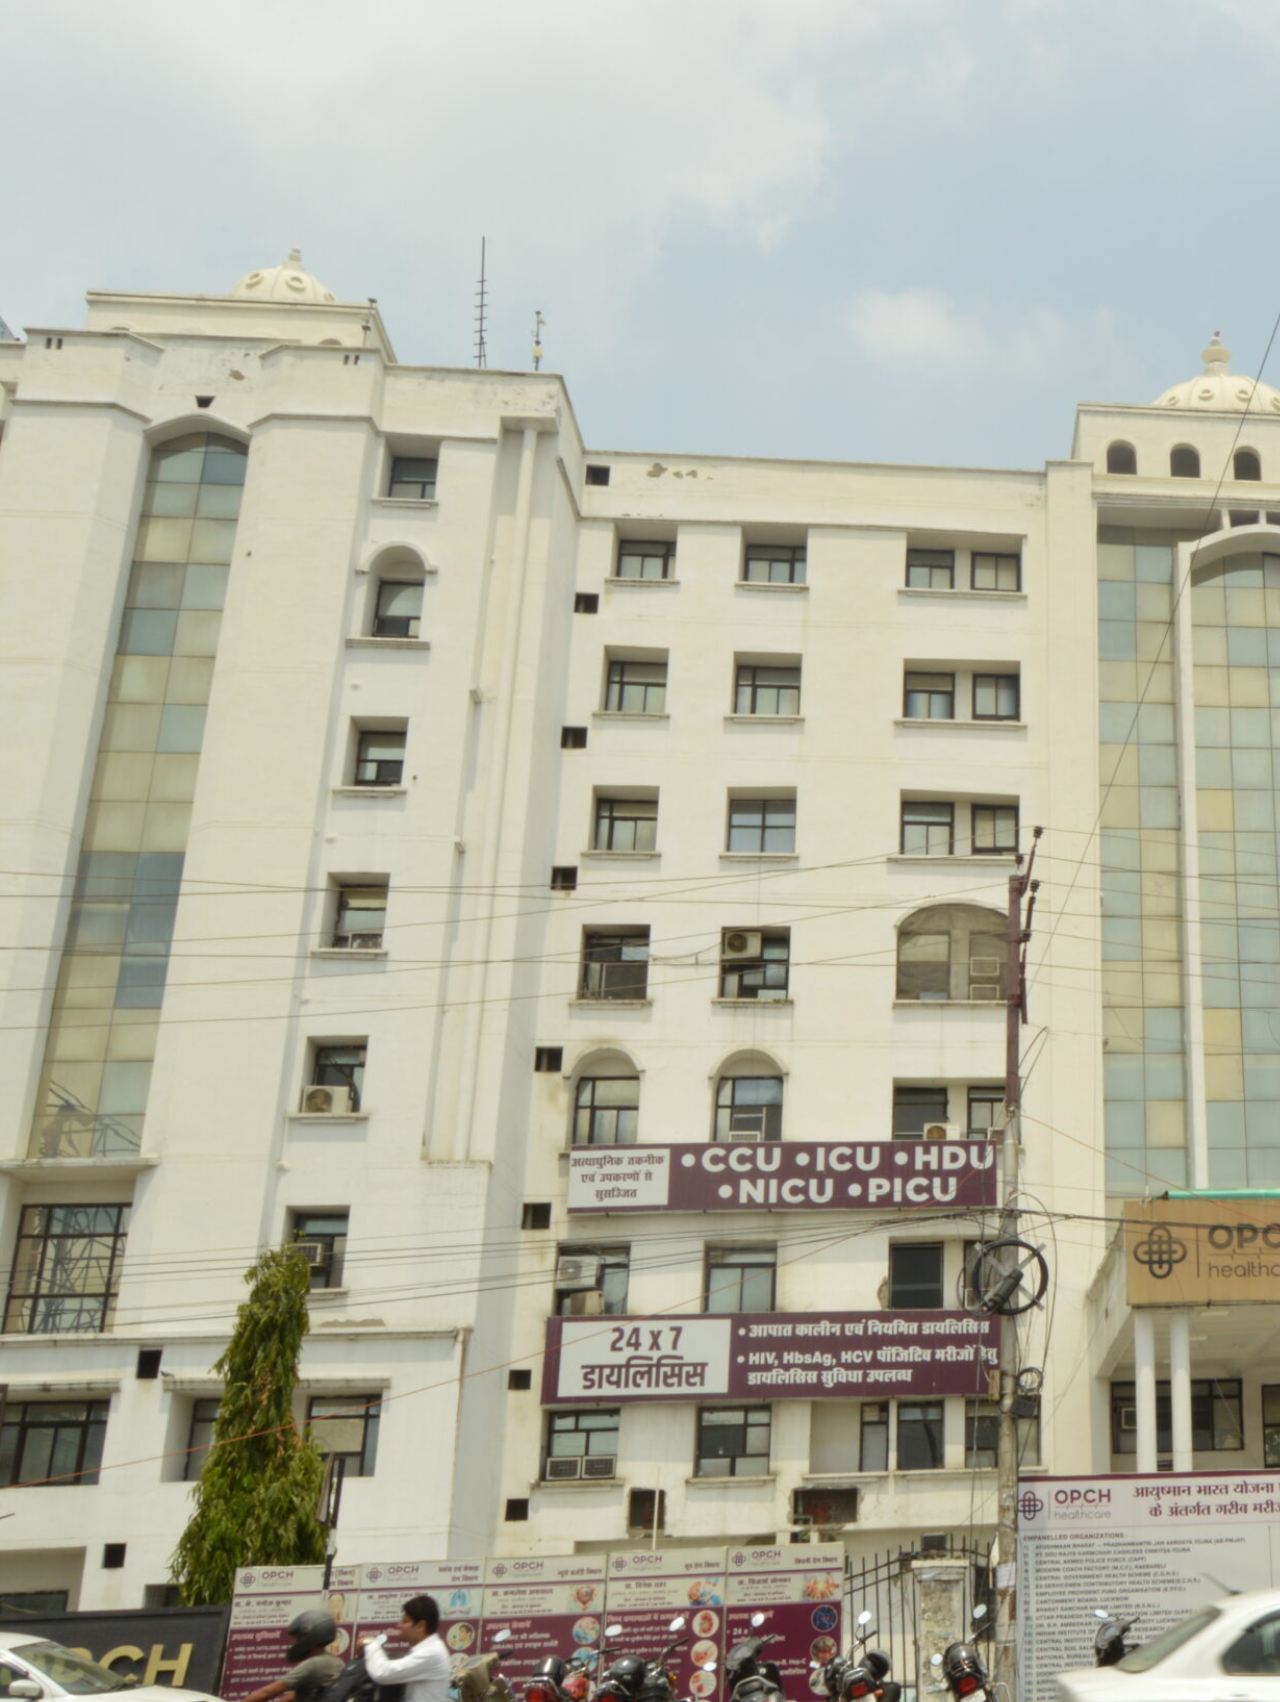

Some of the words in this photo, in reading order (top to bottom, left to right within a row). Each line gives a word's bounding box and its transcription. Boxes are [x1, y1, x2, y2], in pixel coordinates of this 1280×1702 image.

[627, 1154, 665, 1167] तकनीक
[701, 1147, 782, 1173] CCU
[816, 1146, 881, 1172] ICU
[914, 1145, 994, 1171] HDU
[599, 1170, 642, 1183] उपकरणों
[738, 1178, 834, 1204] NICU
[868, 1177, 958, 1203] PICU
[748, 1323, 793, 1338] आपात
[795, 1320, 841, 1337] कालीन
[844, 1319, 865, 1336] एवं
[867, 1320, 919, 1336] नियमित
[921, 1318, 991, 1335] डायलिसिस
[610, 1326, 642, 1353] 24
[669, 1326, 683, 1351] 7
[748, 1351, 779, 1367] HIV,
[782, 1351, 837, 1367] HbsAg,
[840, 1350, 874, 1364] HCV
[580, 1354, 709, 1390] डायलिसिस
[747, 1367, 818, 1386] डायलिसिस
[820, 1367, 863, 1388] सुविधा
[865, 1368, 914, 1384] उपलब्ध
[1054, 1488, 1112, 1504] OPCH
[1133, 1484, 1192, 1500] आयुष्मान
[1196, 1482, 1229, 1496] भारत
[1233, 1479, 1275, 1495] योजना
[1148, 1504, 1163, 1518] के
[1168, 1501, 1211, 1518] अंतर्गत
[1215, 1499, 1248, 1515] गरीब
[632, 1555, 663, 1564] OPCH
[751, 1550, 782, 1559] OPCH
[387, 1565, 420, 1575] OPCH
[512, 1561, 544, 1571] OPCH
[261, 1570, 294, 1580] OPCH
